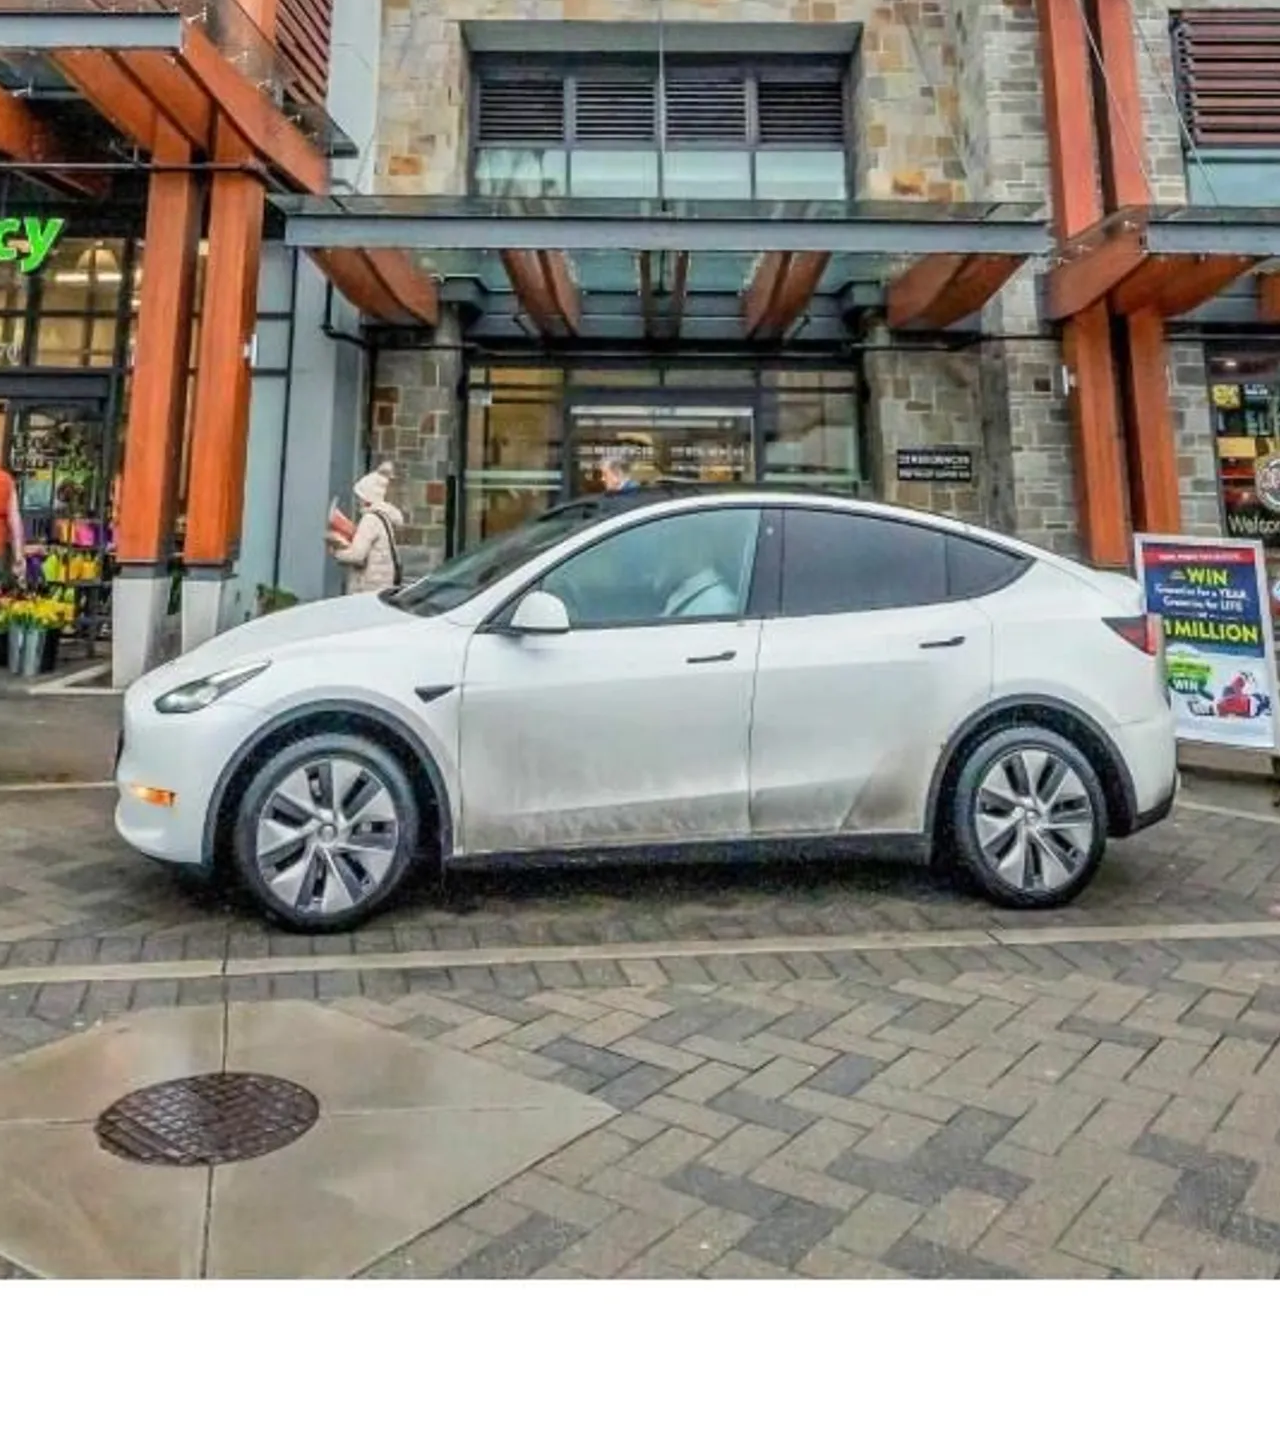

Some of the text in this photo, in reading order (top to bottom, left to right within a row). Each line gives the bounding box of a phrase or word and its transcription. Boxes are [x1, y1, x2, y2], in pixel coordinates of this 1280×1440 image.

[1185, 567, 1228, 586] WIN
[1175, 620, 1259, 644] MILLION
[1172, 679, 1199, 693] WIN
